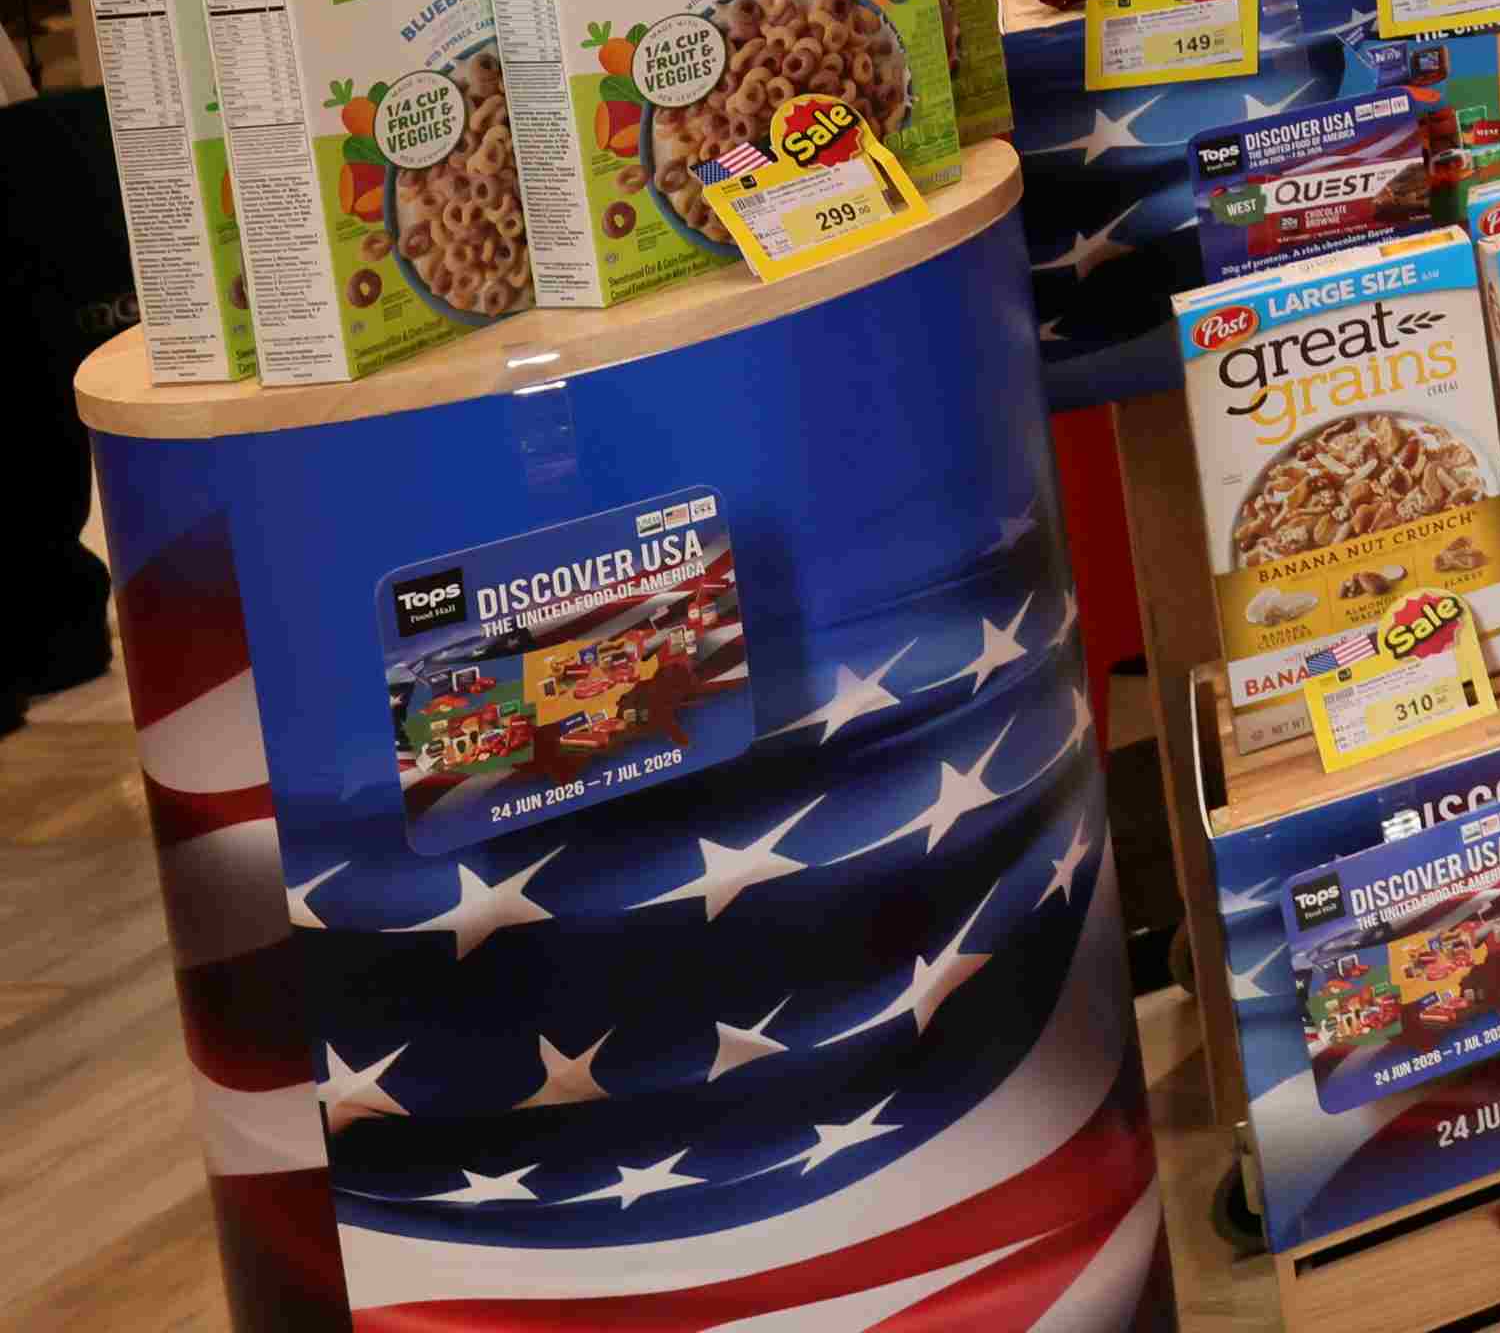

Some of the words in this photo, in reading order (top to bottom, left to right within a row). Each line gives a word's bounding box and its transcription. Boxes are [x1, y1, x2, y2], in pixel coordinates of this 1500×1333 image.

[644, 39, 672, 58] 1/4
[675, 30, 711, 51] CUP
[1174, 34, 1211, 52] 149
[646, 49, 696, 77] FRUIT
[1245, 119, 1320, 151] DISCOVER
[1323, 111, 1354, 132] USA
[1199, 144, 1240, 163] Tops
[816, 203, 857, 231] 299
[1226, 198, 1257, 217] WEST
[1268, 280, 1356, 318] LARGE
[1361, 265, 1418, 295] SIZE
[1218, 302, 1400, 416] great
[1250, 340, 1458, 446] grains
[476, 549, 635, 620] DISCOVER
[640, 529, 703, 571] USA
[1257, 553, 1339, 583] BANANA
[1347, 539, 1385, 560] NUT
[411, 608, 433, 625] Food
[435, 605, 456, 620] Hall
[482, 617, 513, 638] THE
[516, 602, 570, 629] UNITED
[640, 562, 706, 594] AMERICA
[1395, 694, 1434, 721] 310
[491, 803, 512, 822] 24
[514, 793, 542, 816] JUN
[545, 780, 585, 806] 2026
[603, 770, 613, 785] 7
[617, 763, 642, 782] JUL
[644, 749, 682, 774] 2026
[1350, 854, 1465, 917] DISCOVER
[1437, 1119, 1470, 1148] 24
